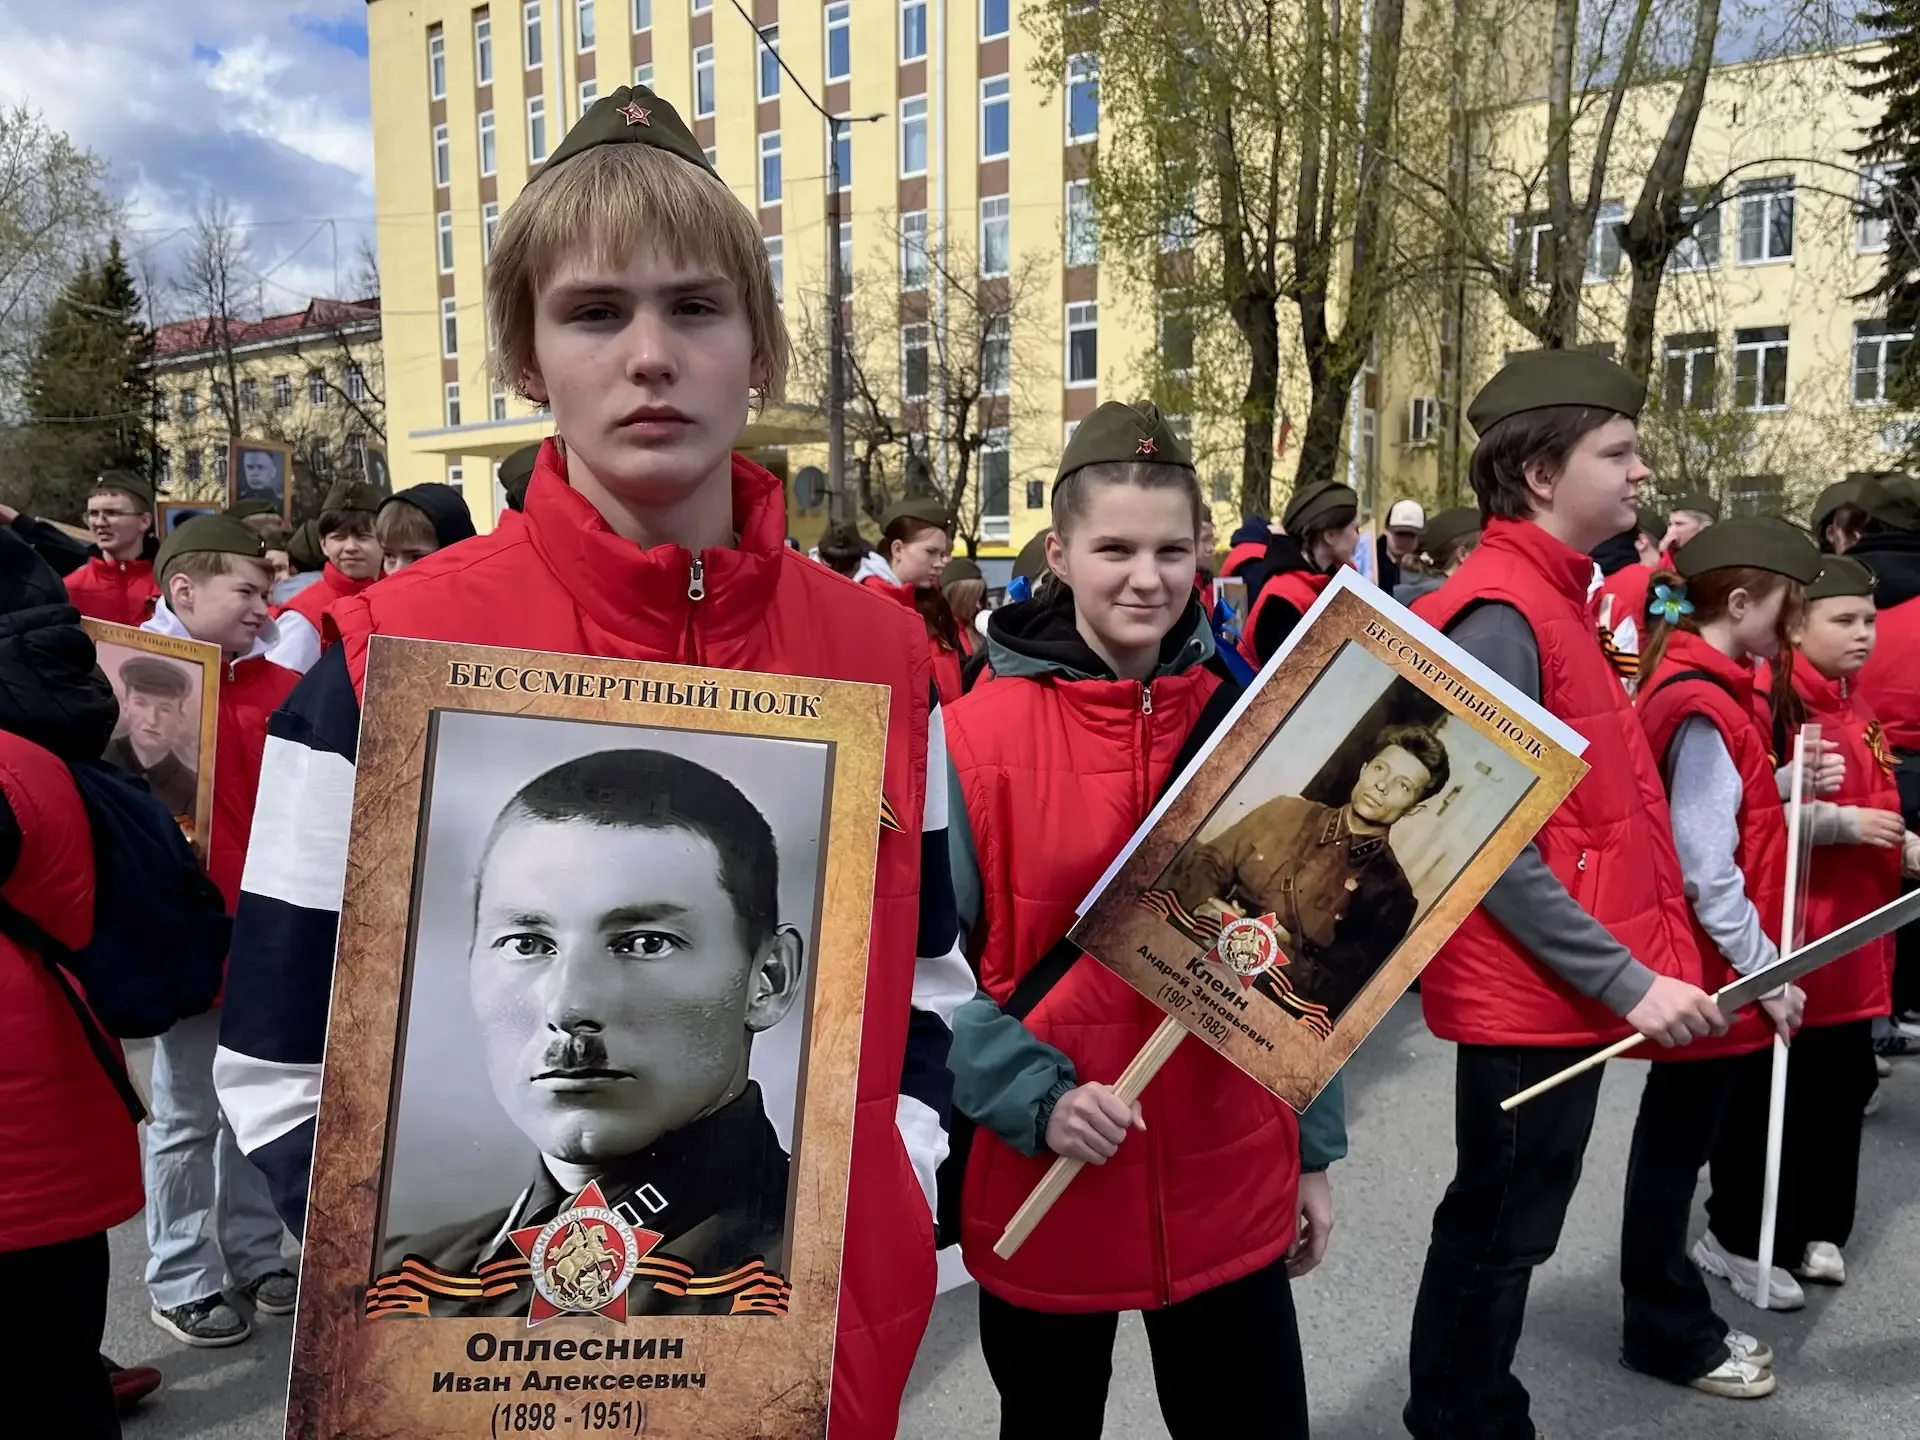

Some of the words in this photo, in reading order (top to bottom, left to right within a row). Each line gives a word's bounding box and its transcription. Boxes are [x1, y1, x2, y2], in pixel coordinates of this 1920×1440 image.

[448, 661, 720, 710] БЕССМЕРТНЫЙ
[729, 687, 821, 718] ПОЛК
[1363, 619, 1498, 723] БЕССМЕРТНЫЙ
[1494, 716, 1548, 761] ПОЛК
[1137, 945, 1190, 988] Андрей
[1192, 984, 1275, 1052] Зиновьевич
[1156, 982, 1193, 1012] (1907
[1198, 1013, 1230, 1044] 1982)
[592, 1208, 622, 1229] ПОЛК
[466, 1332, 684, 1362] Оплеснин
[432, 1371, 511, 1392] Иван
[521, 1370, 707, 1391] Алексеевич
[491, 1402, 556, 1439] (1898
[580, 1401, 642, 1436] 1951)
